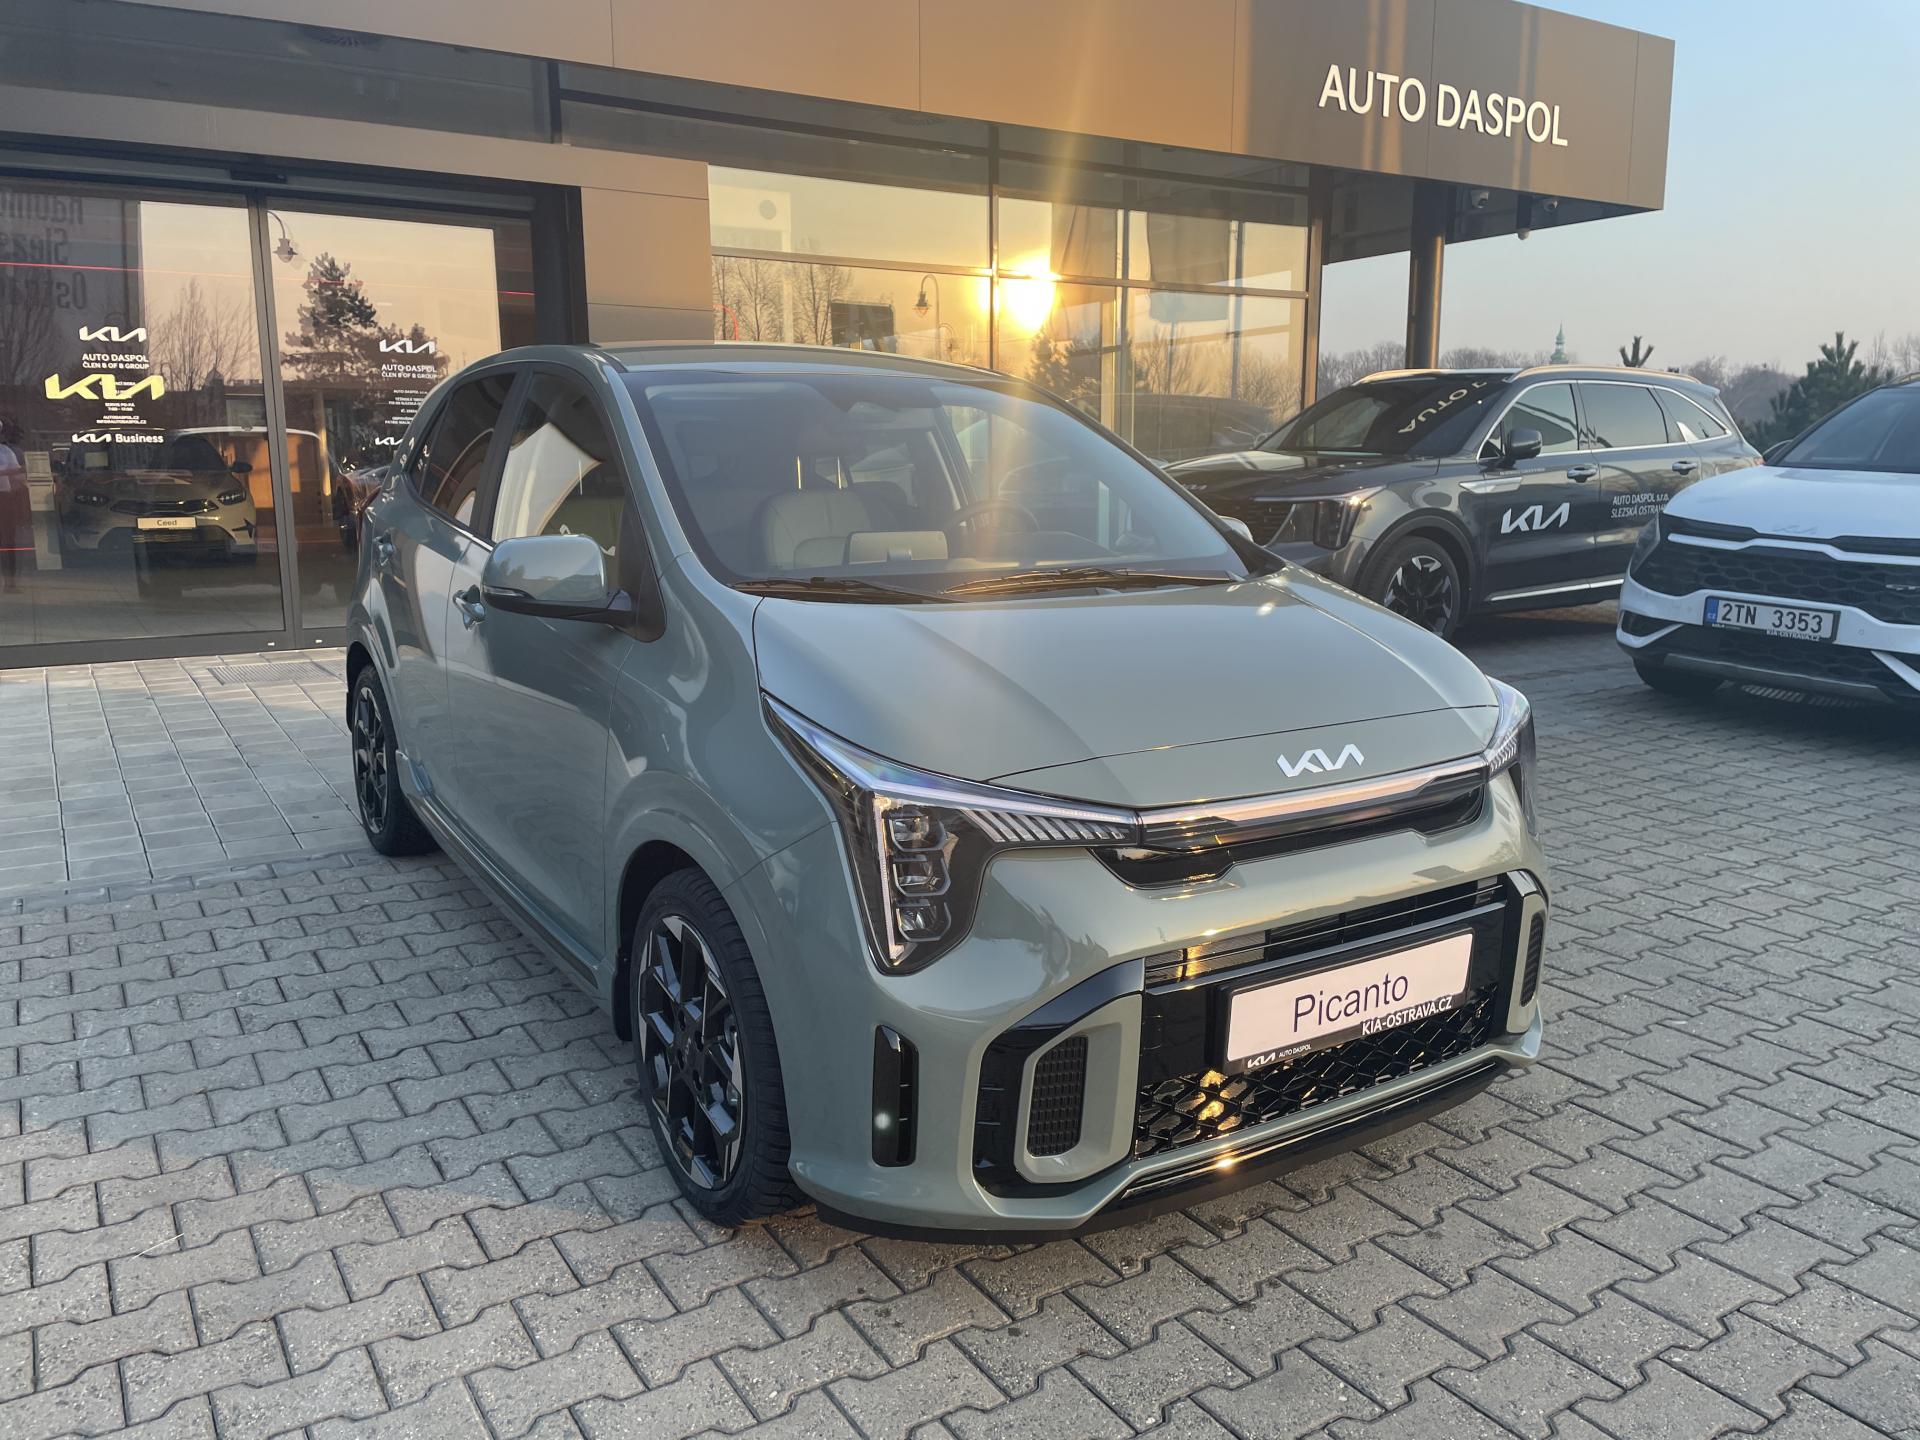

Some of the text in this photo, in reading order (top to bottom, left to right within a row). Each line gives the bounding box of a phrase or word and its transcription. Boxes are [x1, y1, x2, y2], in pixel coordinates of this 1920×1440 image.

[1318, 64, 1568, 146] AUTO DASPOL
[79, 326, 147, 342] KIA
[379, 339, 436, 355] KIA
[82, 353, 149, 363] AUTO DASPOL
[82, 361, 101, 369] ČLEN
[381, 364, 437, 373] AUTO DASPOL
[45, 373, 165, 400] KIA
[72, 433, 164, 443] KIA Business
[1612, 494, 1630, 505] AUTO
[1632, 493, 1655, 504] DASPOL
[1501, 502, 1570, 533] KIA
[1611, 505, 1637, 518] SLEZSKÁ
[1721, 603, 1757, 625] 2TN
[1772, 610, 1823, 634] 3353
[1277, 743, 1364, 777] KIA
[1293, 973, 1408, 1033] Picanto
[1361, 995, 1453, 1036] KIA-OSTRAVA.CZ
[1247, 1044, 1311, 1069] KIA AUTO DASPOL
